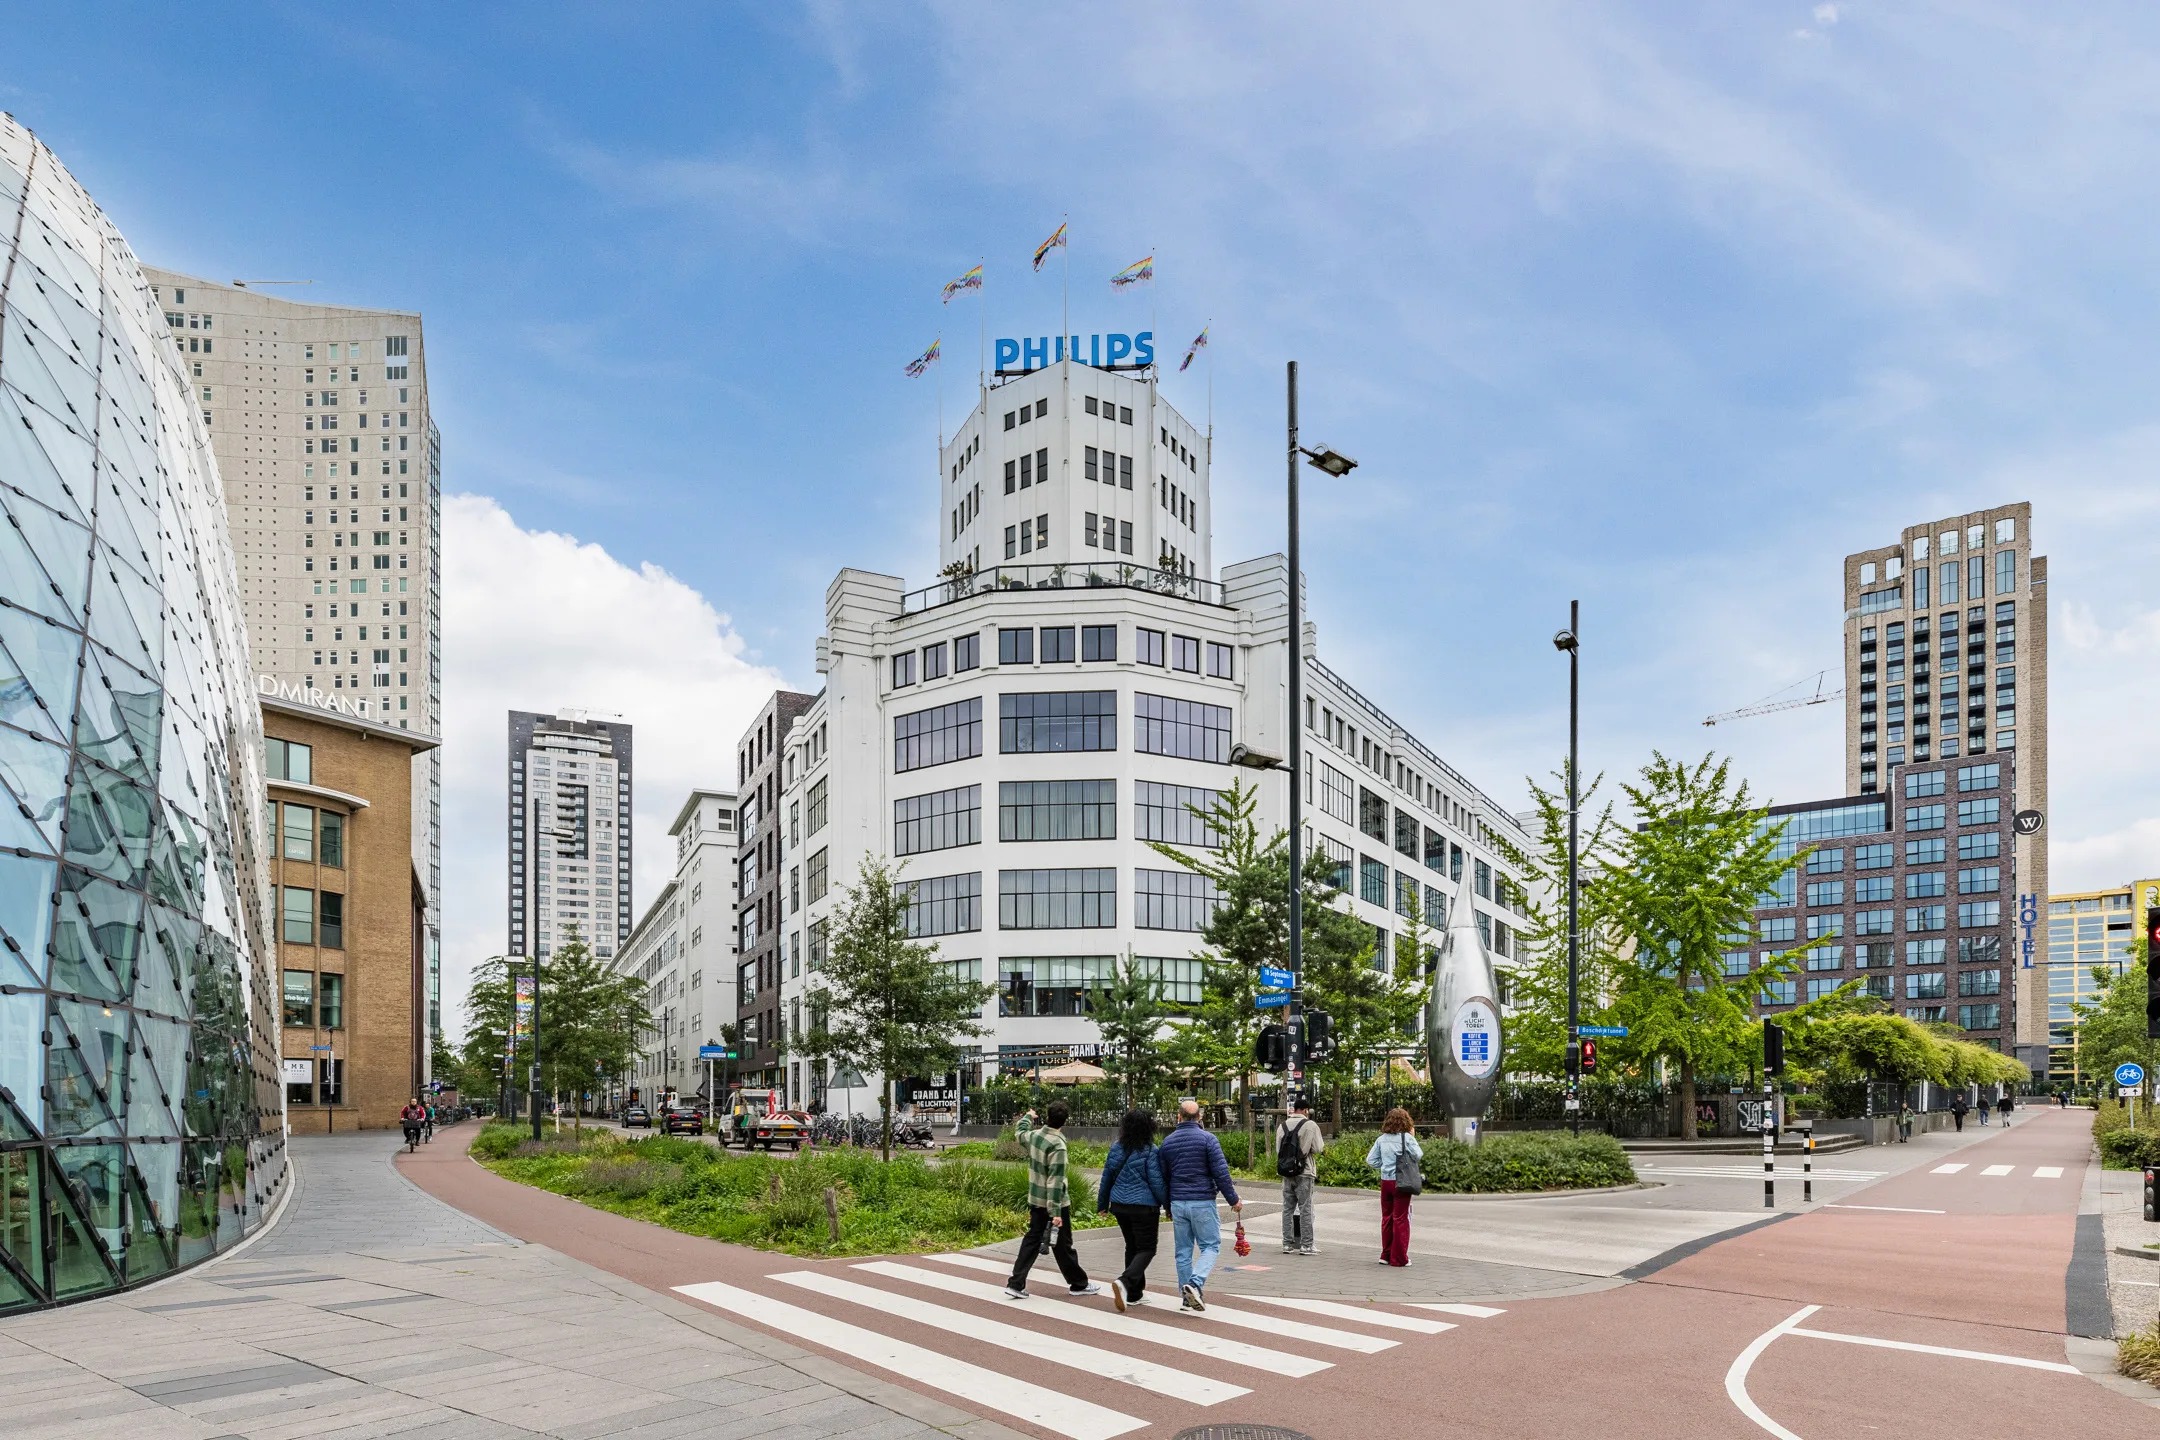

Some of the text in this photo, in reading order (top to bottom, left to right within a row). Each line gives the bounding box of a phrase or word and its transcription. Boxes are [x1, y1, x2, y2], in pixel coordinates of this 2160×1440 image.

[995, 331, 1154, 371] PHILIPS
[257, 674, 374, 720] DMIRANT
[2019, 816, 2038, 829] W
[2019, 893, 2037, 970] HOTEL
[1258, 994, 1288, 1005] Emmasingel
[1069, 1044, 1097, 1058] GRAND
[912, 1090, 940, 1100] GRAND
